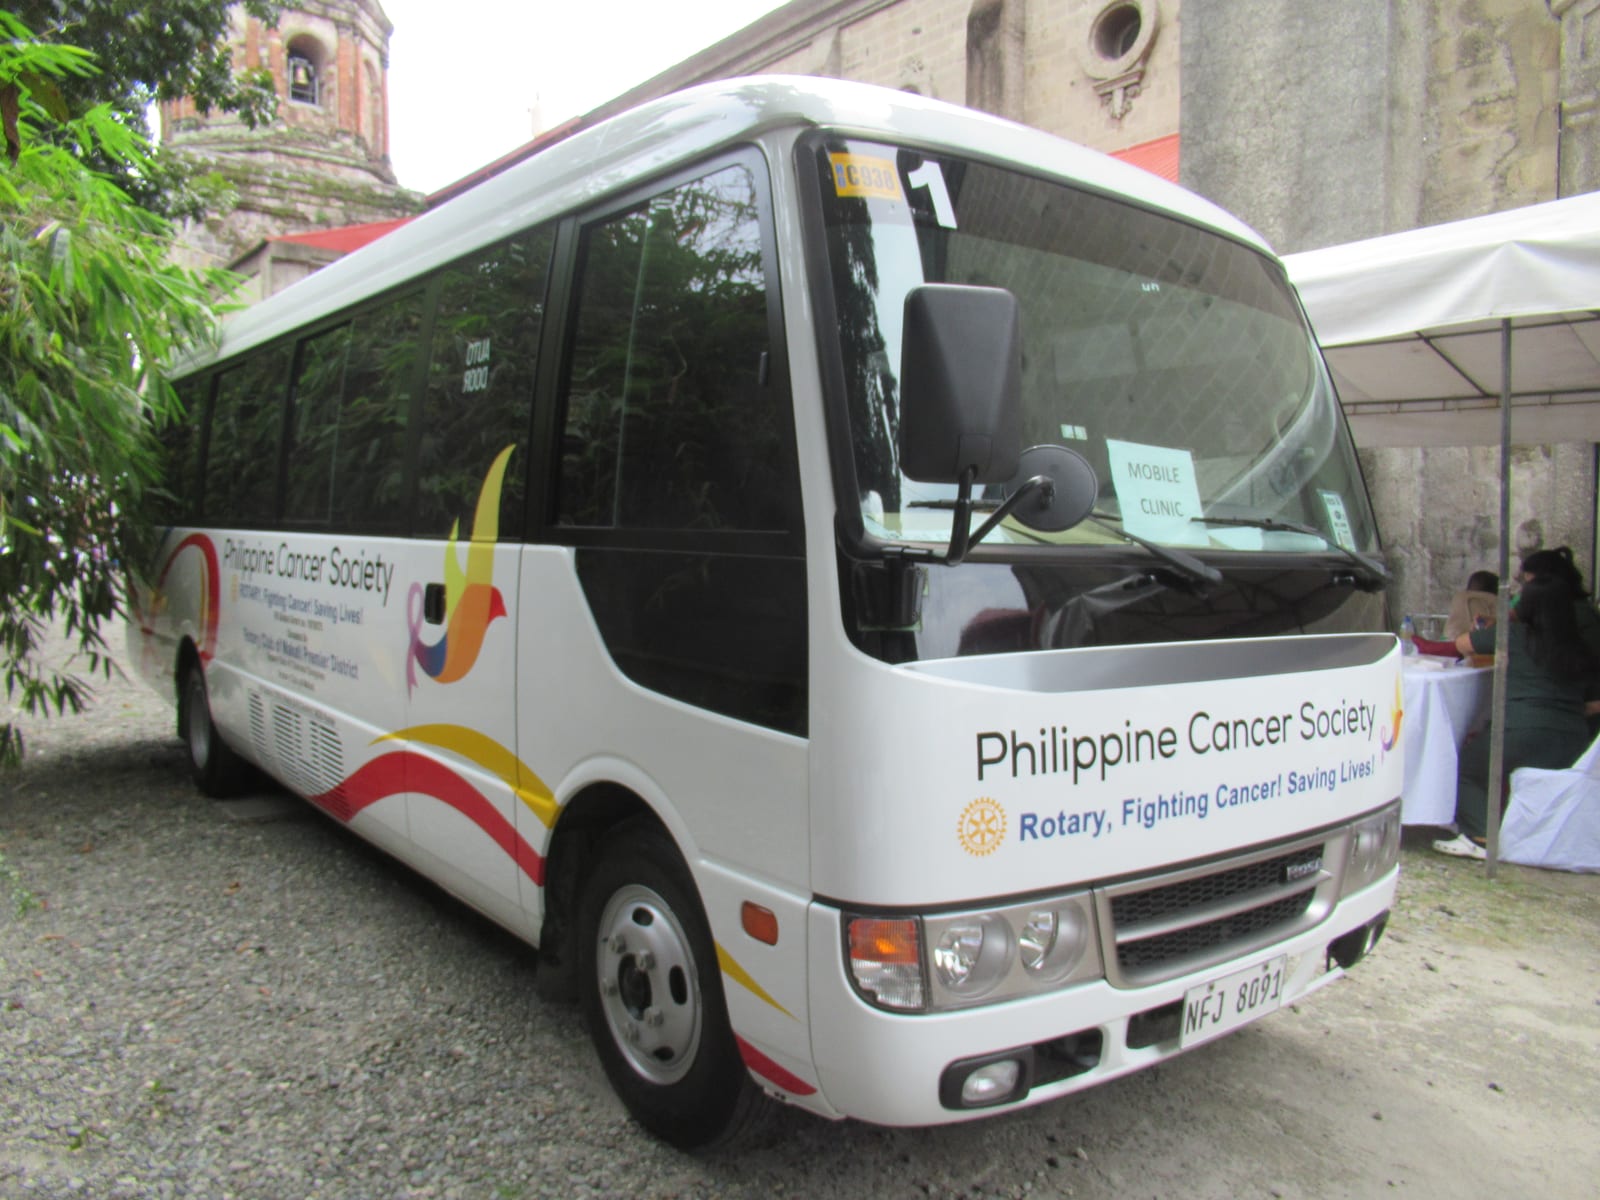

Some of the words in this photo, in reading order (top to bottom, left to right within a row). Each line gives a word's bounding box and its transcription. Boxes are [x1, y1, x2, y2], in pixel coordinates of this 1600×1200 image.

[908, 160, 957, 229] 1
[1127, 462, 1181, 484] MOBILE
[1140, 498, 1185, 518] CLINIC
[223, 538, 275, 582] Philippine
[277, 542, 327, 583] Cancer
[329, 546, 394, 607] Society
[976, 720, 1178, 785] Philippine
[1188, 711, 1293, 755] Cancer
[1300, 699, 1377, 742] Society
[1019, 808, 1113, 842] Rotary,
[1122, 789, 1209, 828] Fighting
[1216, 774, 1282, 809] Cancer!
[1287, 765, 1337, 794] Saving
[1341, 755, 1375, 783] Lives!
[1185, 990, 1225, 1034] NFJ
[1236, 970, 1281, 1013] 8091
